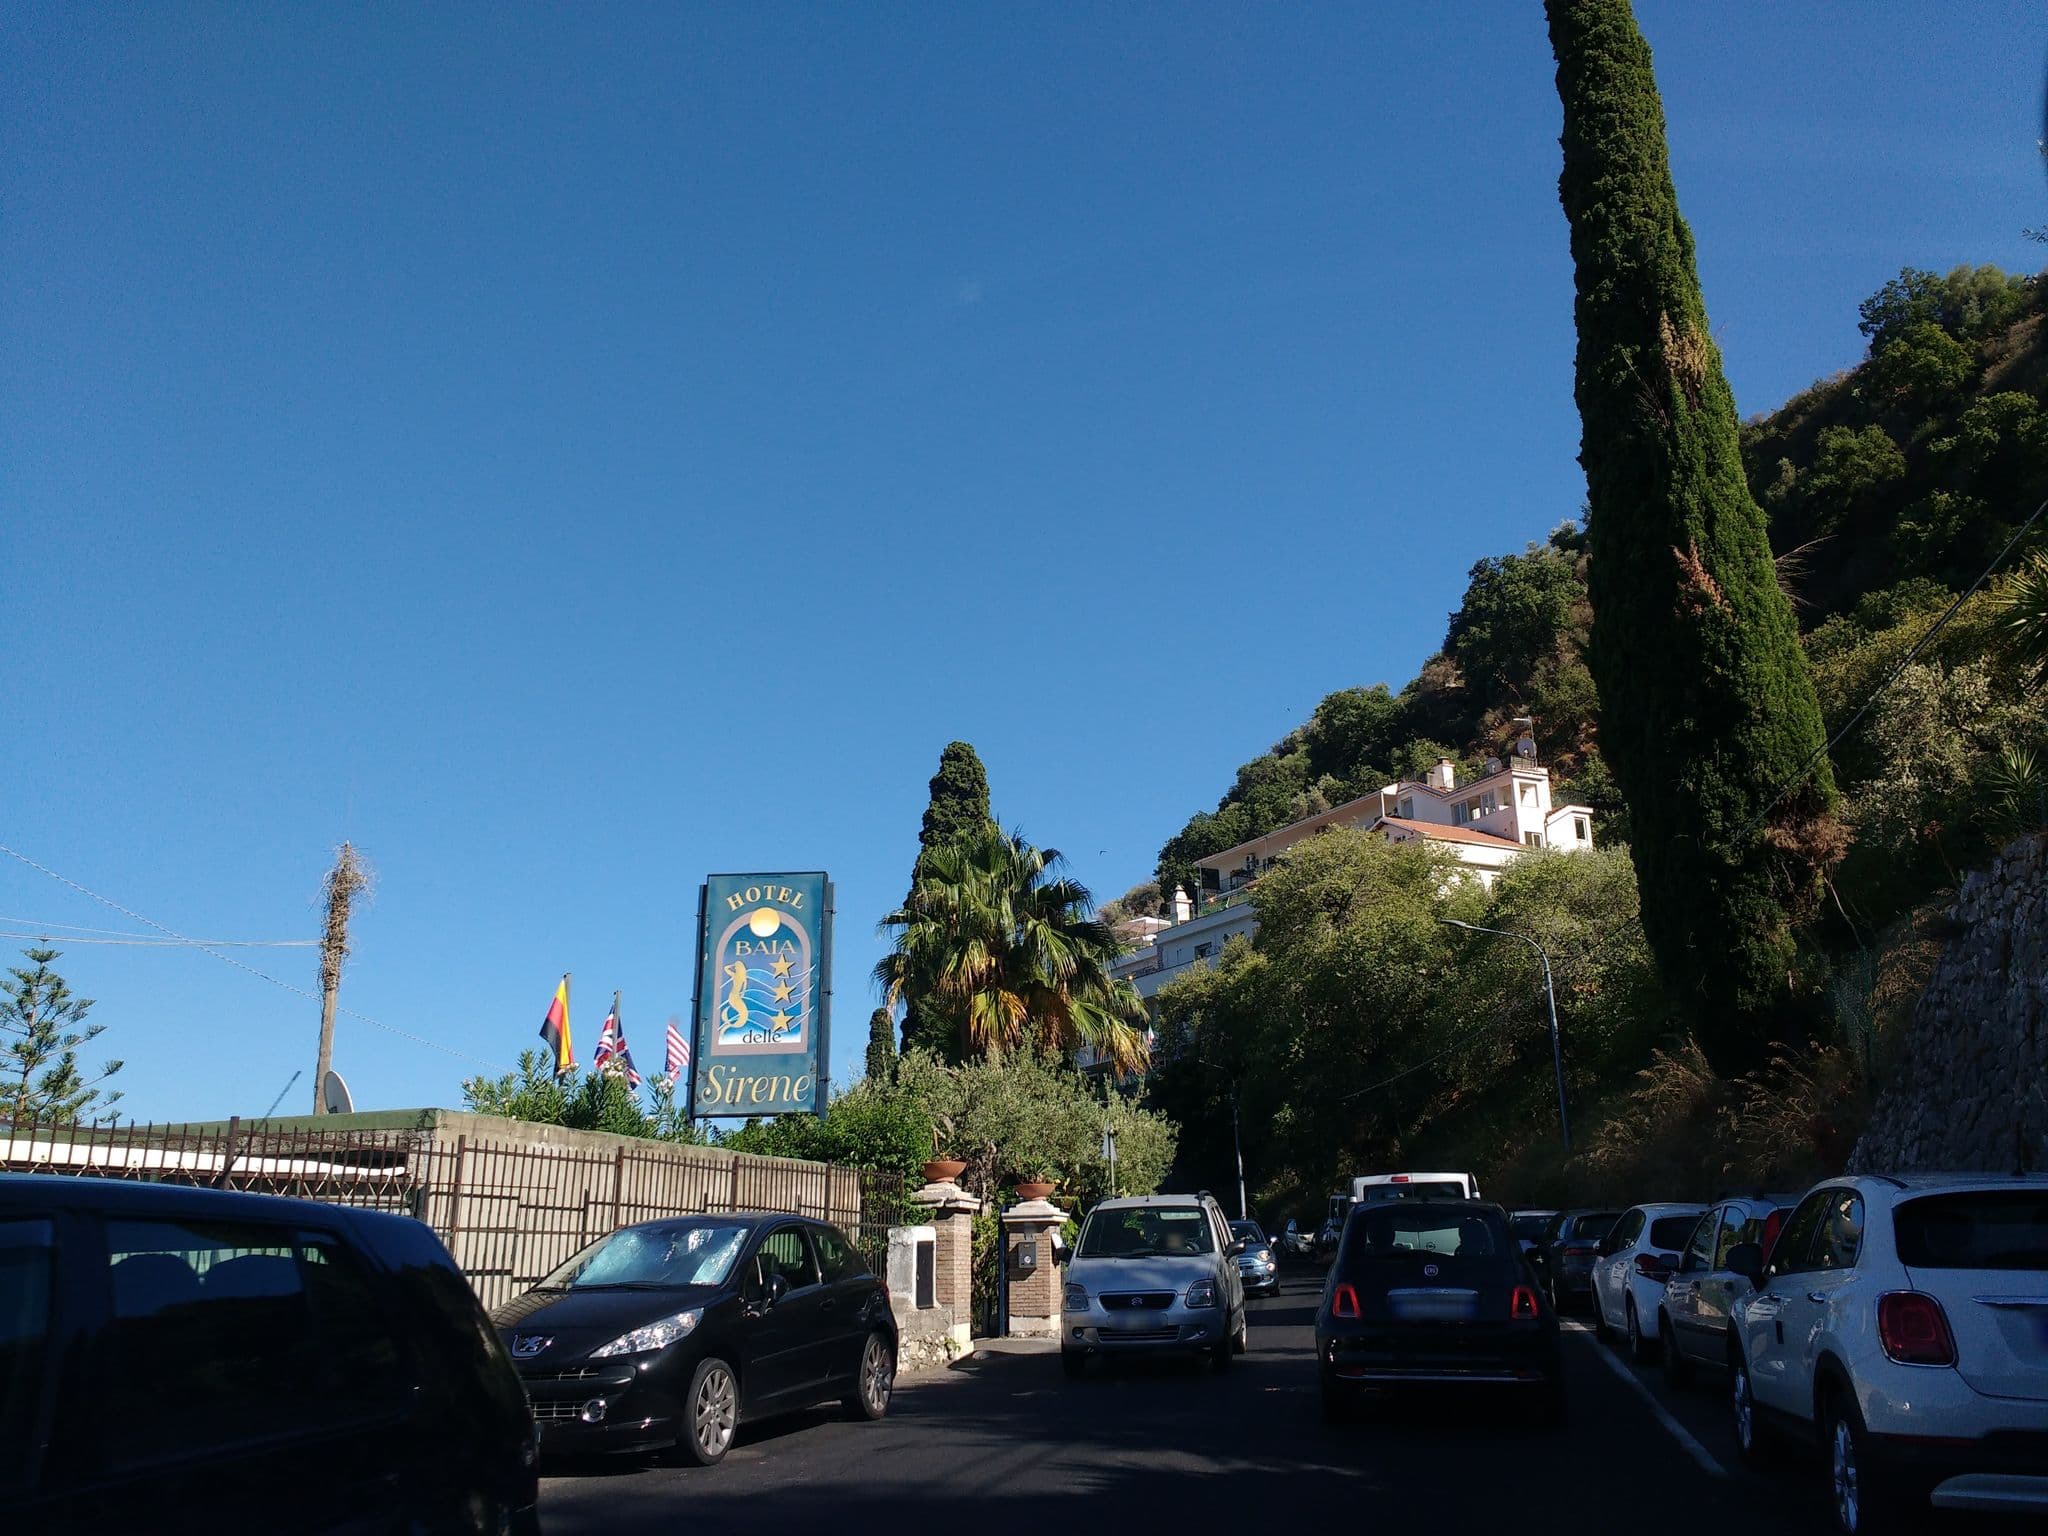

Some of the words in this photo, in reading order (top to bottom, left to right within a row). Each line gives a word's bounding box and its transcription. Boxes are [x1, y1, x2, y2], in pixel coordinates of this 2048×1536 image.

[726, 885, 805, 912] HOTEL
[735, 939, 797, 956] BAIA
[742, 1029, 782, 1044] delle
[701, 1064, 811, 1105] Sirene
